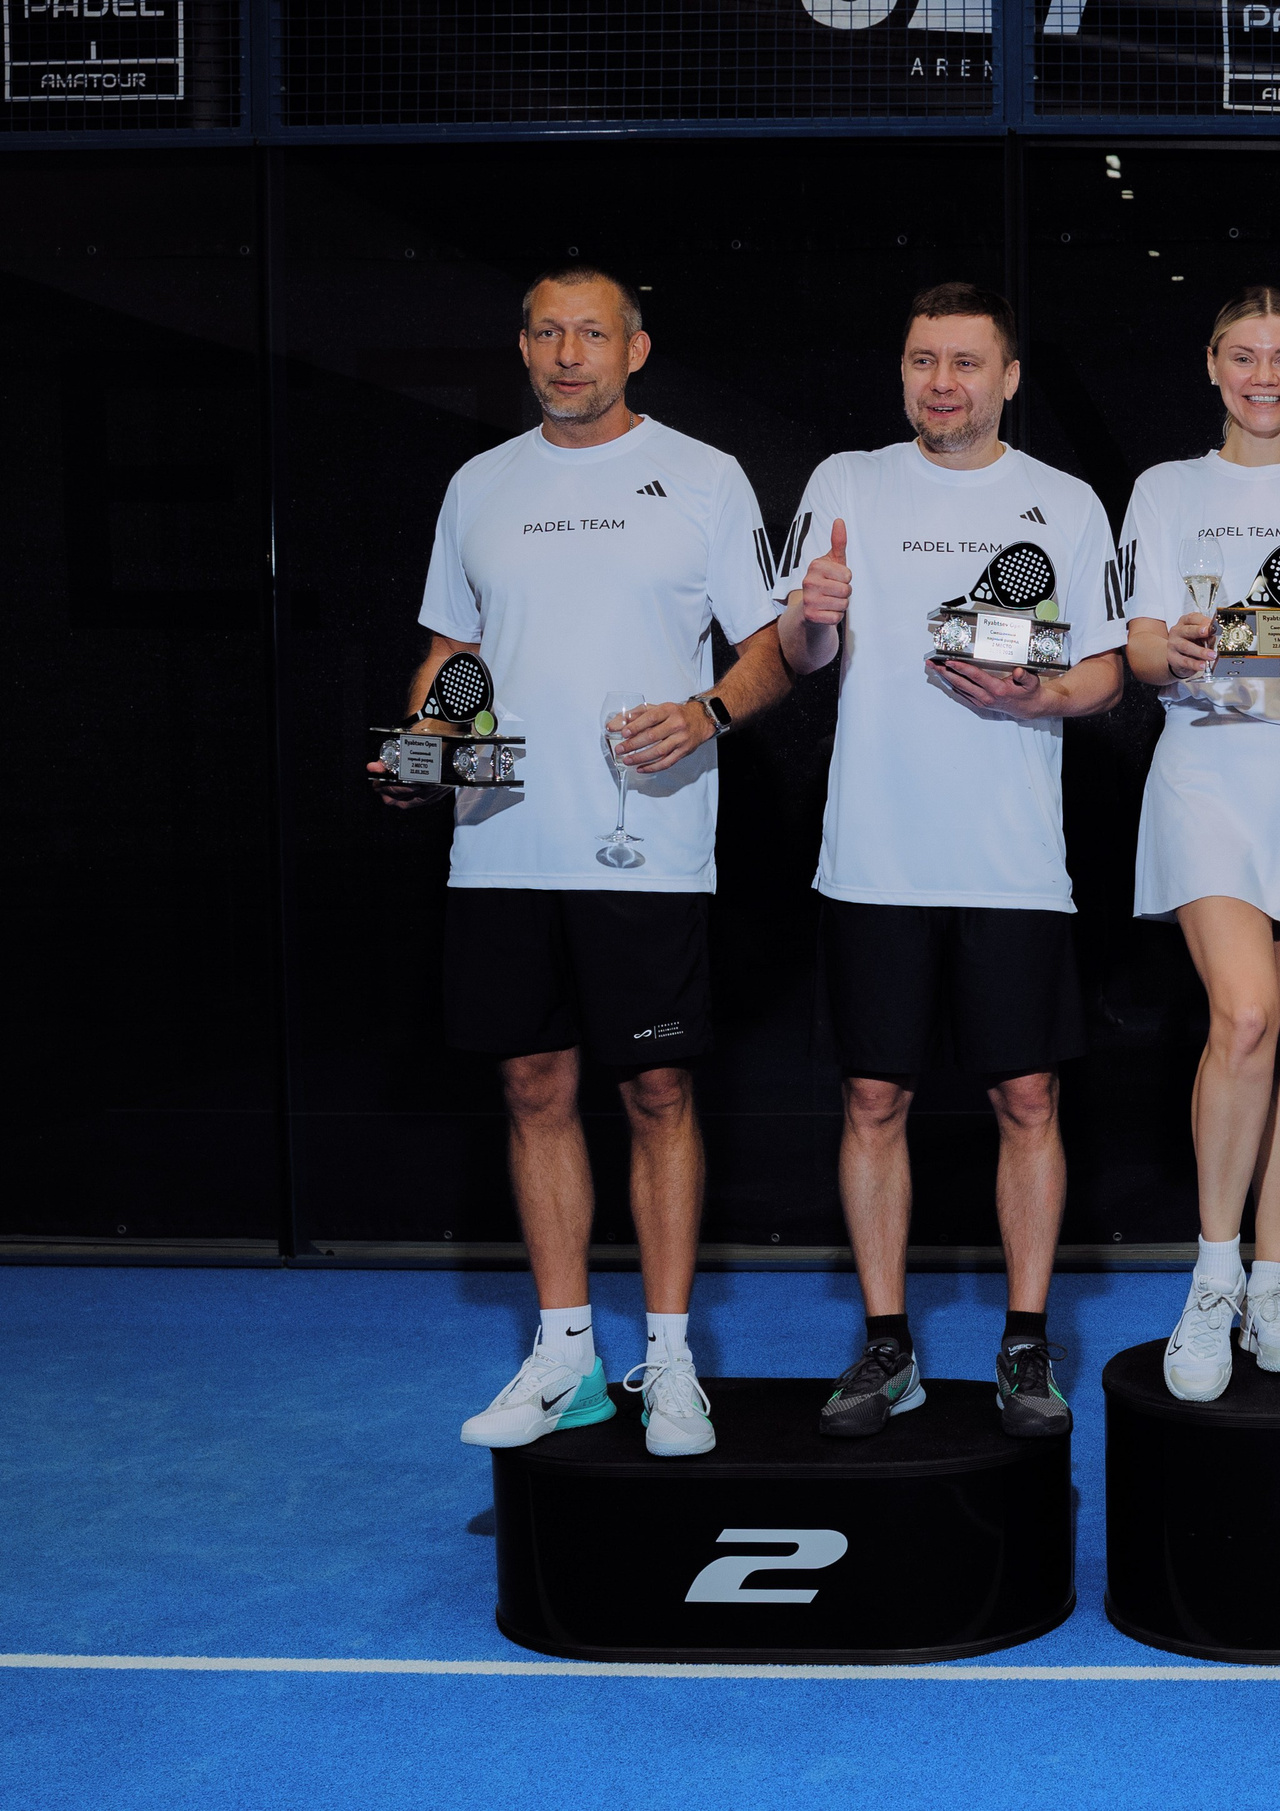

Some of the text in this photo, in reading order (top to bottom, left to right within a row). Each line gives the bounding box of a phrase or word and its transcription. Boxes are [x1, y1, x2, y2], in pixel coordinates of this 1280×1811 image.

[41, 73, 146, 89] AMATOUR
[523, 518, 626, 535] PADEL TEAM
[1198, 526, 1244, 540] PADEL
[902, 541, 1003, 553] PADEL TEAM
[684, 1528, 849, 1604] 2
